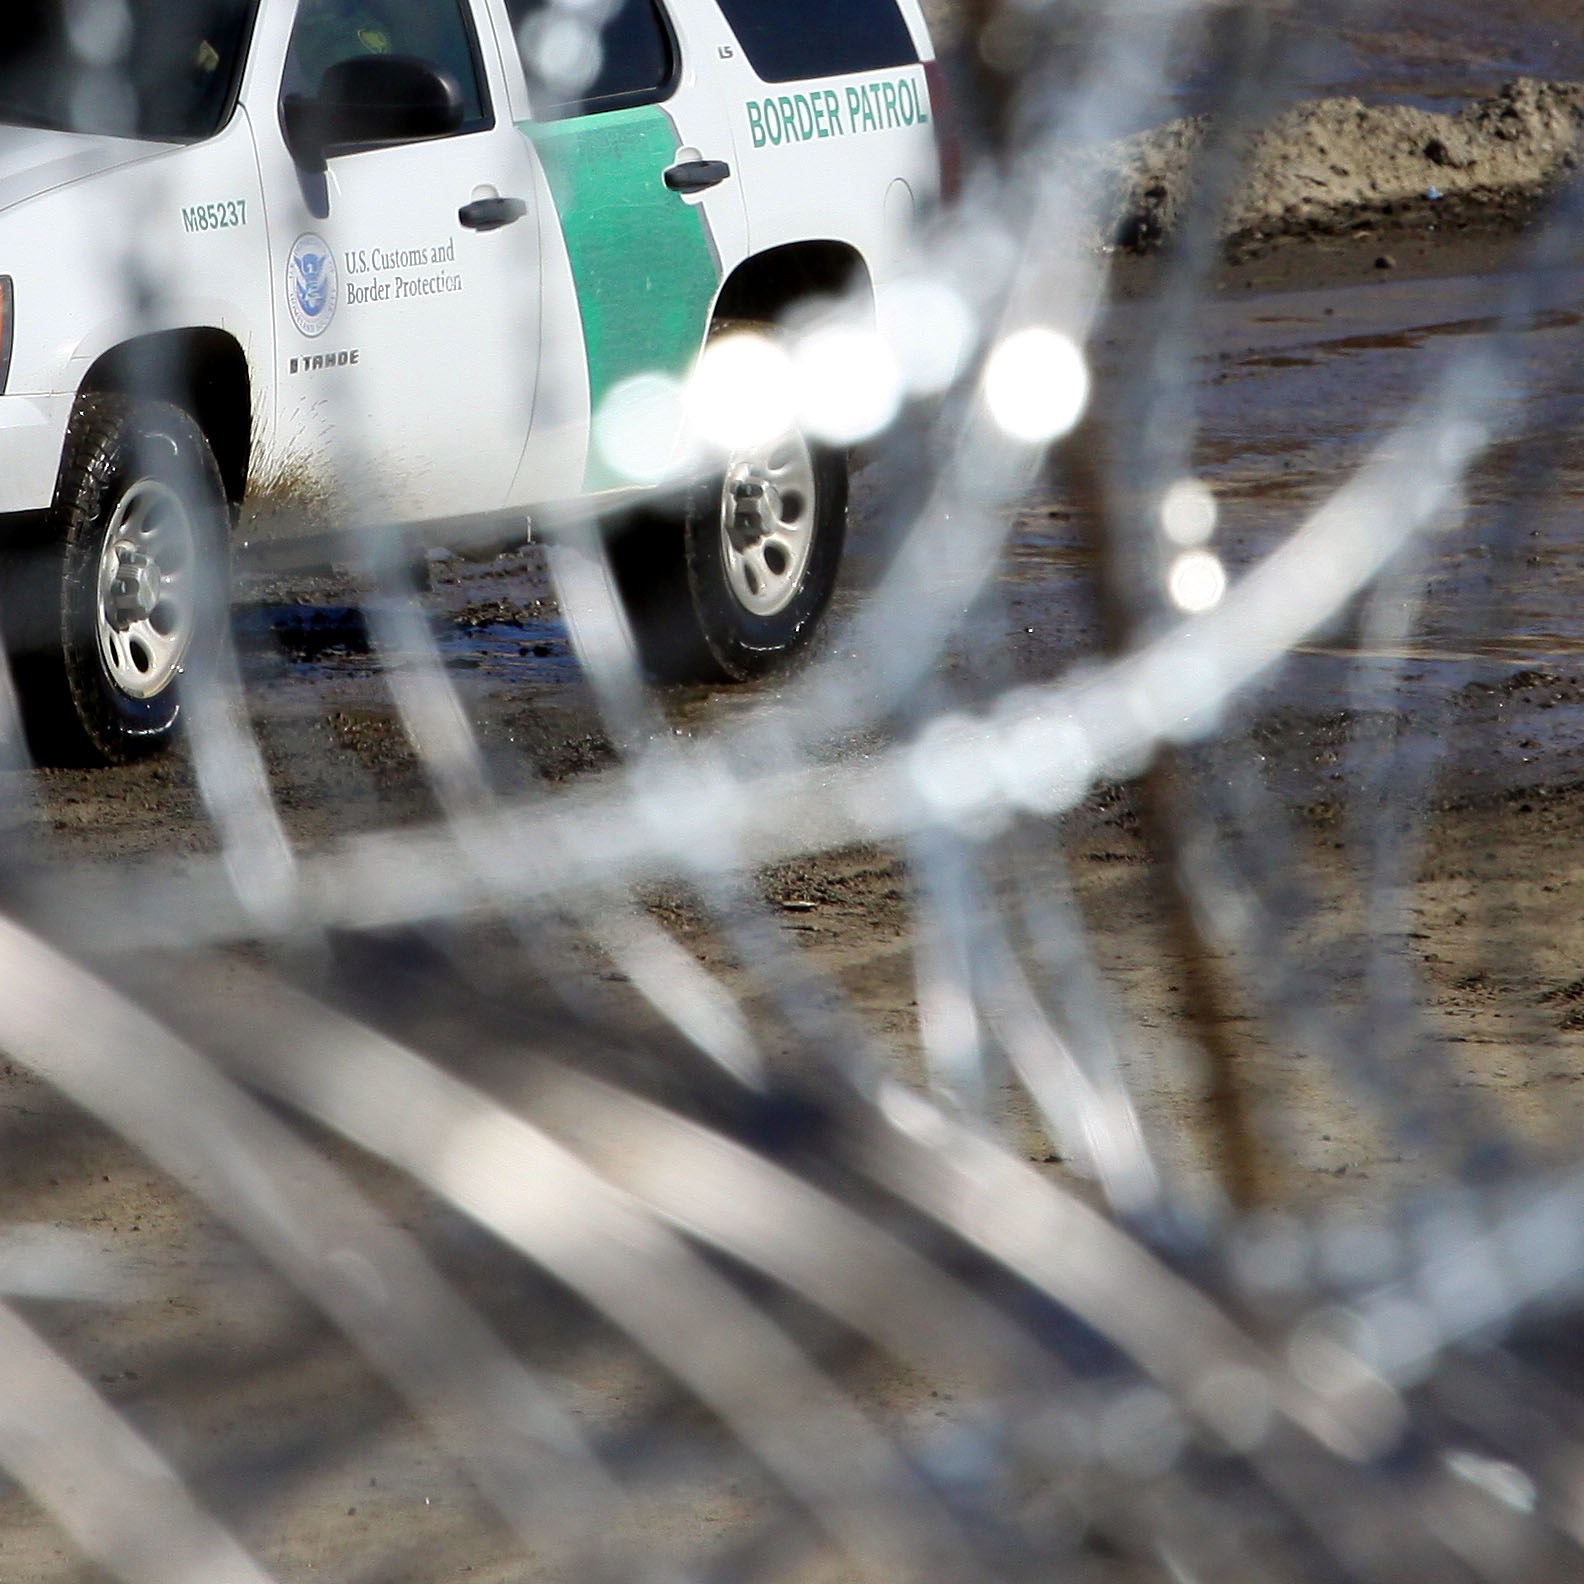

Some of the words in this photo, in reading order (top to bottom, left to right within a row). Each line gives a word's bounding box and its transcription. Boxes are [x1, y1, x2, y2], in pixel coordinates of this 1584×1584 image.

[718, 45, 734, 60] LS
[745, 90, 844, 148] BORDER
[845, 77, 929, 134] PATROL
[181, 200, 248, 233] M85237
[344, 250, 370, 275] U.S.
[371, 246, 429, 273] Customs
[430, 237, 455, 264] and
[346, 277, 391, 305] Border
[395, 270, 463, 300] Protection
[302, 348, 361, 372] TAHOE
